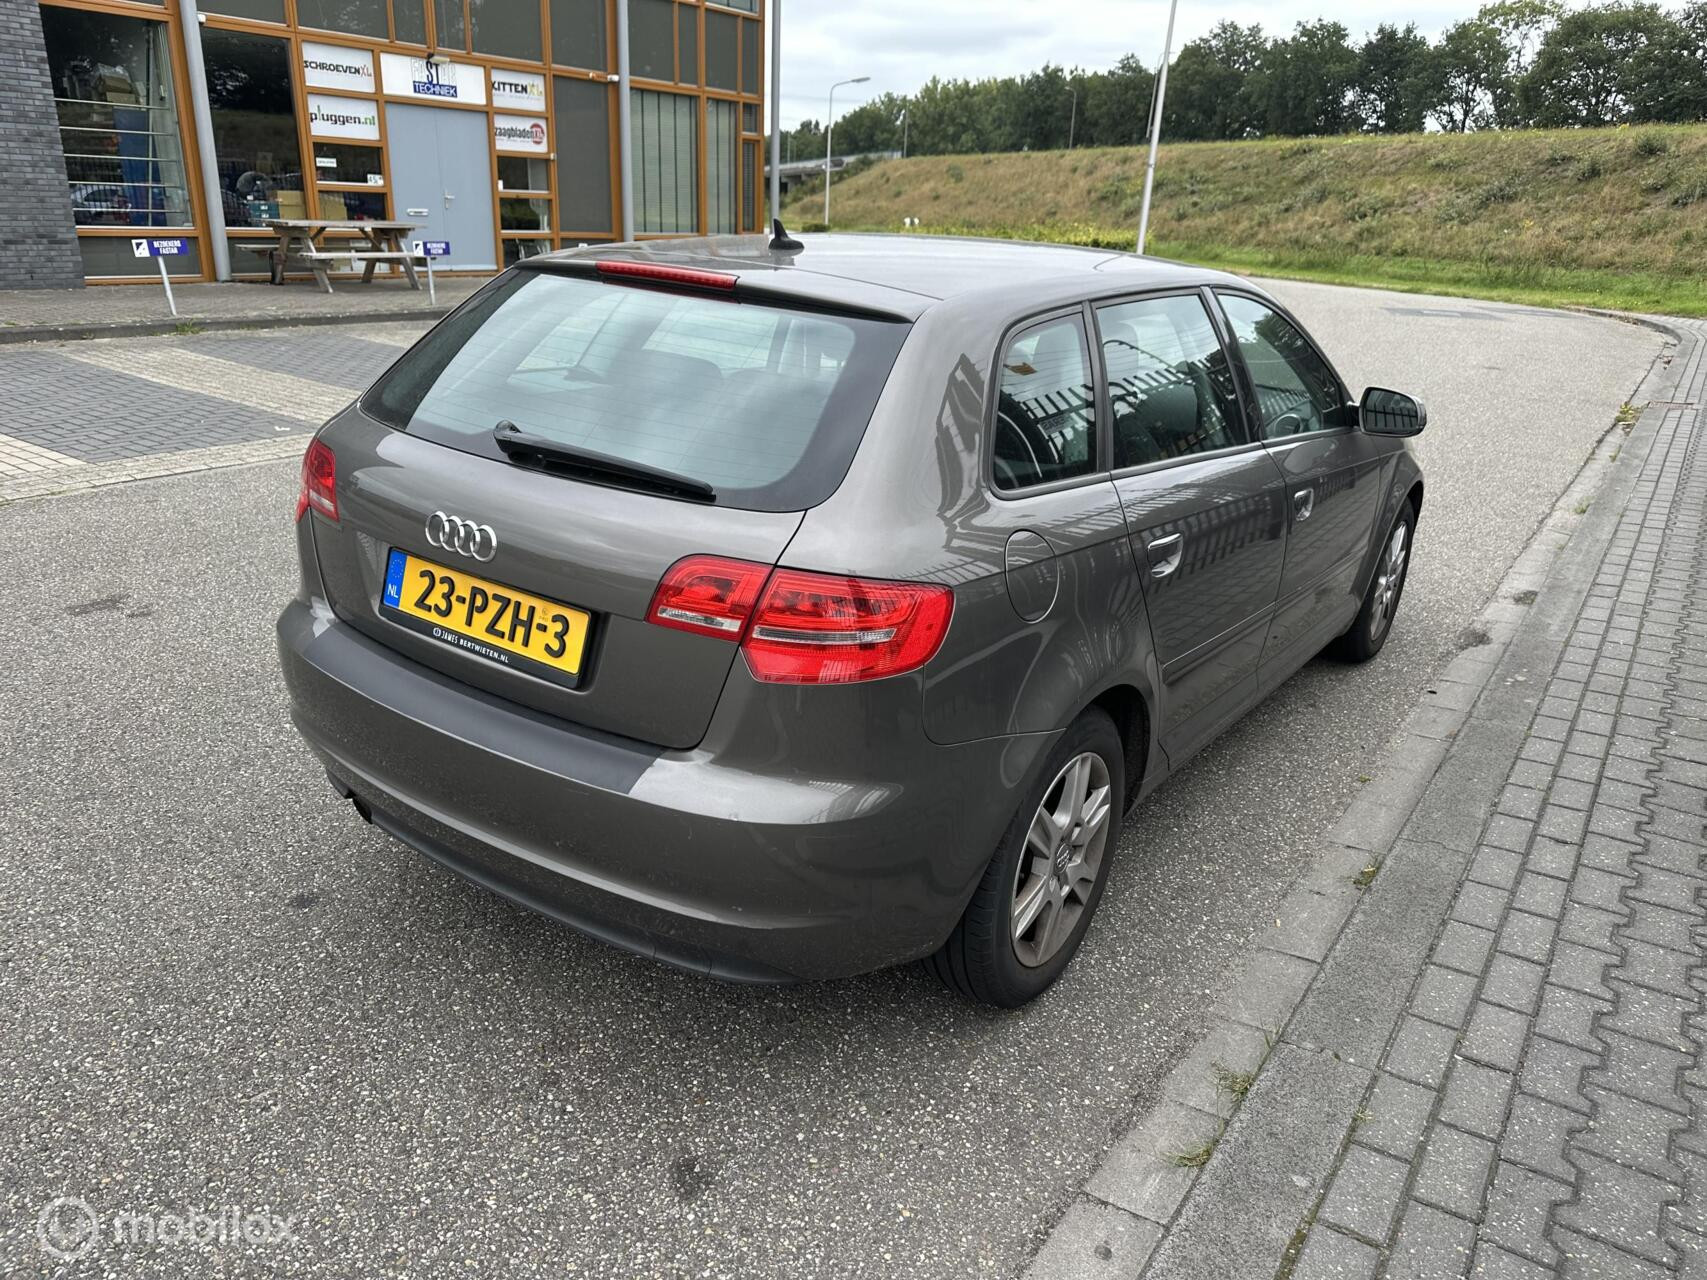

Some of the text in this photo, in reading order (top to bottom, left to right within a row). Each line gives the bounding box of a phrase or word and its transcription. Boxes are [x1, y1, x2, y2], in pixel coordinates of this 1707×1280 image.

[415, 83, 457, 97] TECHNIEK
[310, 104, 376, 126] pluggen.nl
[387, 583, 399, 599] NL
[414, 569, 570, 658] 23-PZH-3
[441, 630, 509, 663] JAMES BERTWIETEN.NL
